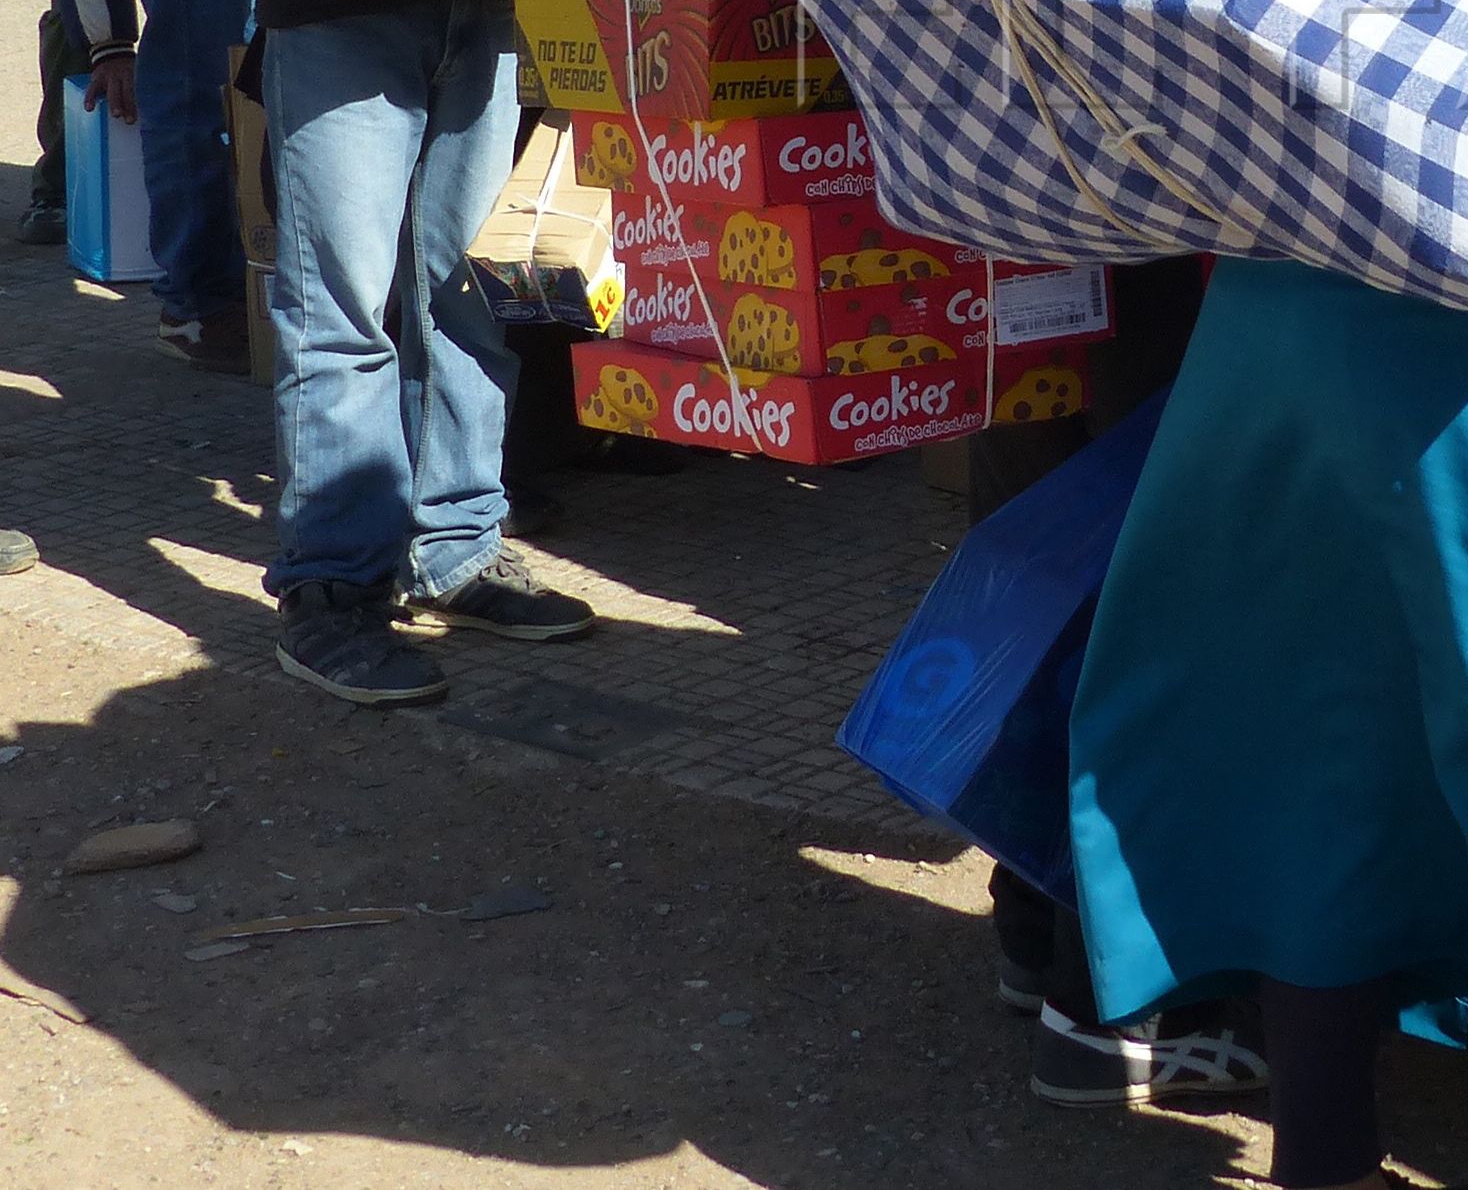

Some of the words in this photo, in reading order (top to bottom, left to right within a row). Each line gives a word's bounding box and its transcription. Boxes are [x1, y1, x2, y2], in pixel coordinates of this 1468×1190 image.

[537, 40, 557, 62] NO
[560, 41, 576, 63] TE
[579, 42, 597, 64] LO
[751, 5, 816, 53] BITS
[550, 68, 608, 93] PIERDAS
[712, 75, 823, 101] ATRÉVETE
[649, 121, 747, 192] Cookies
[614, 194, 684, 250] Cookies
[624, 272, 695, 326] Cookies
[673, 382, 796, 447] Cookies
[829, 375, 955, 431] Cookies
